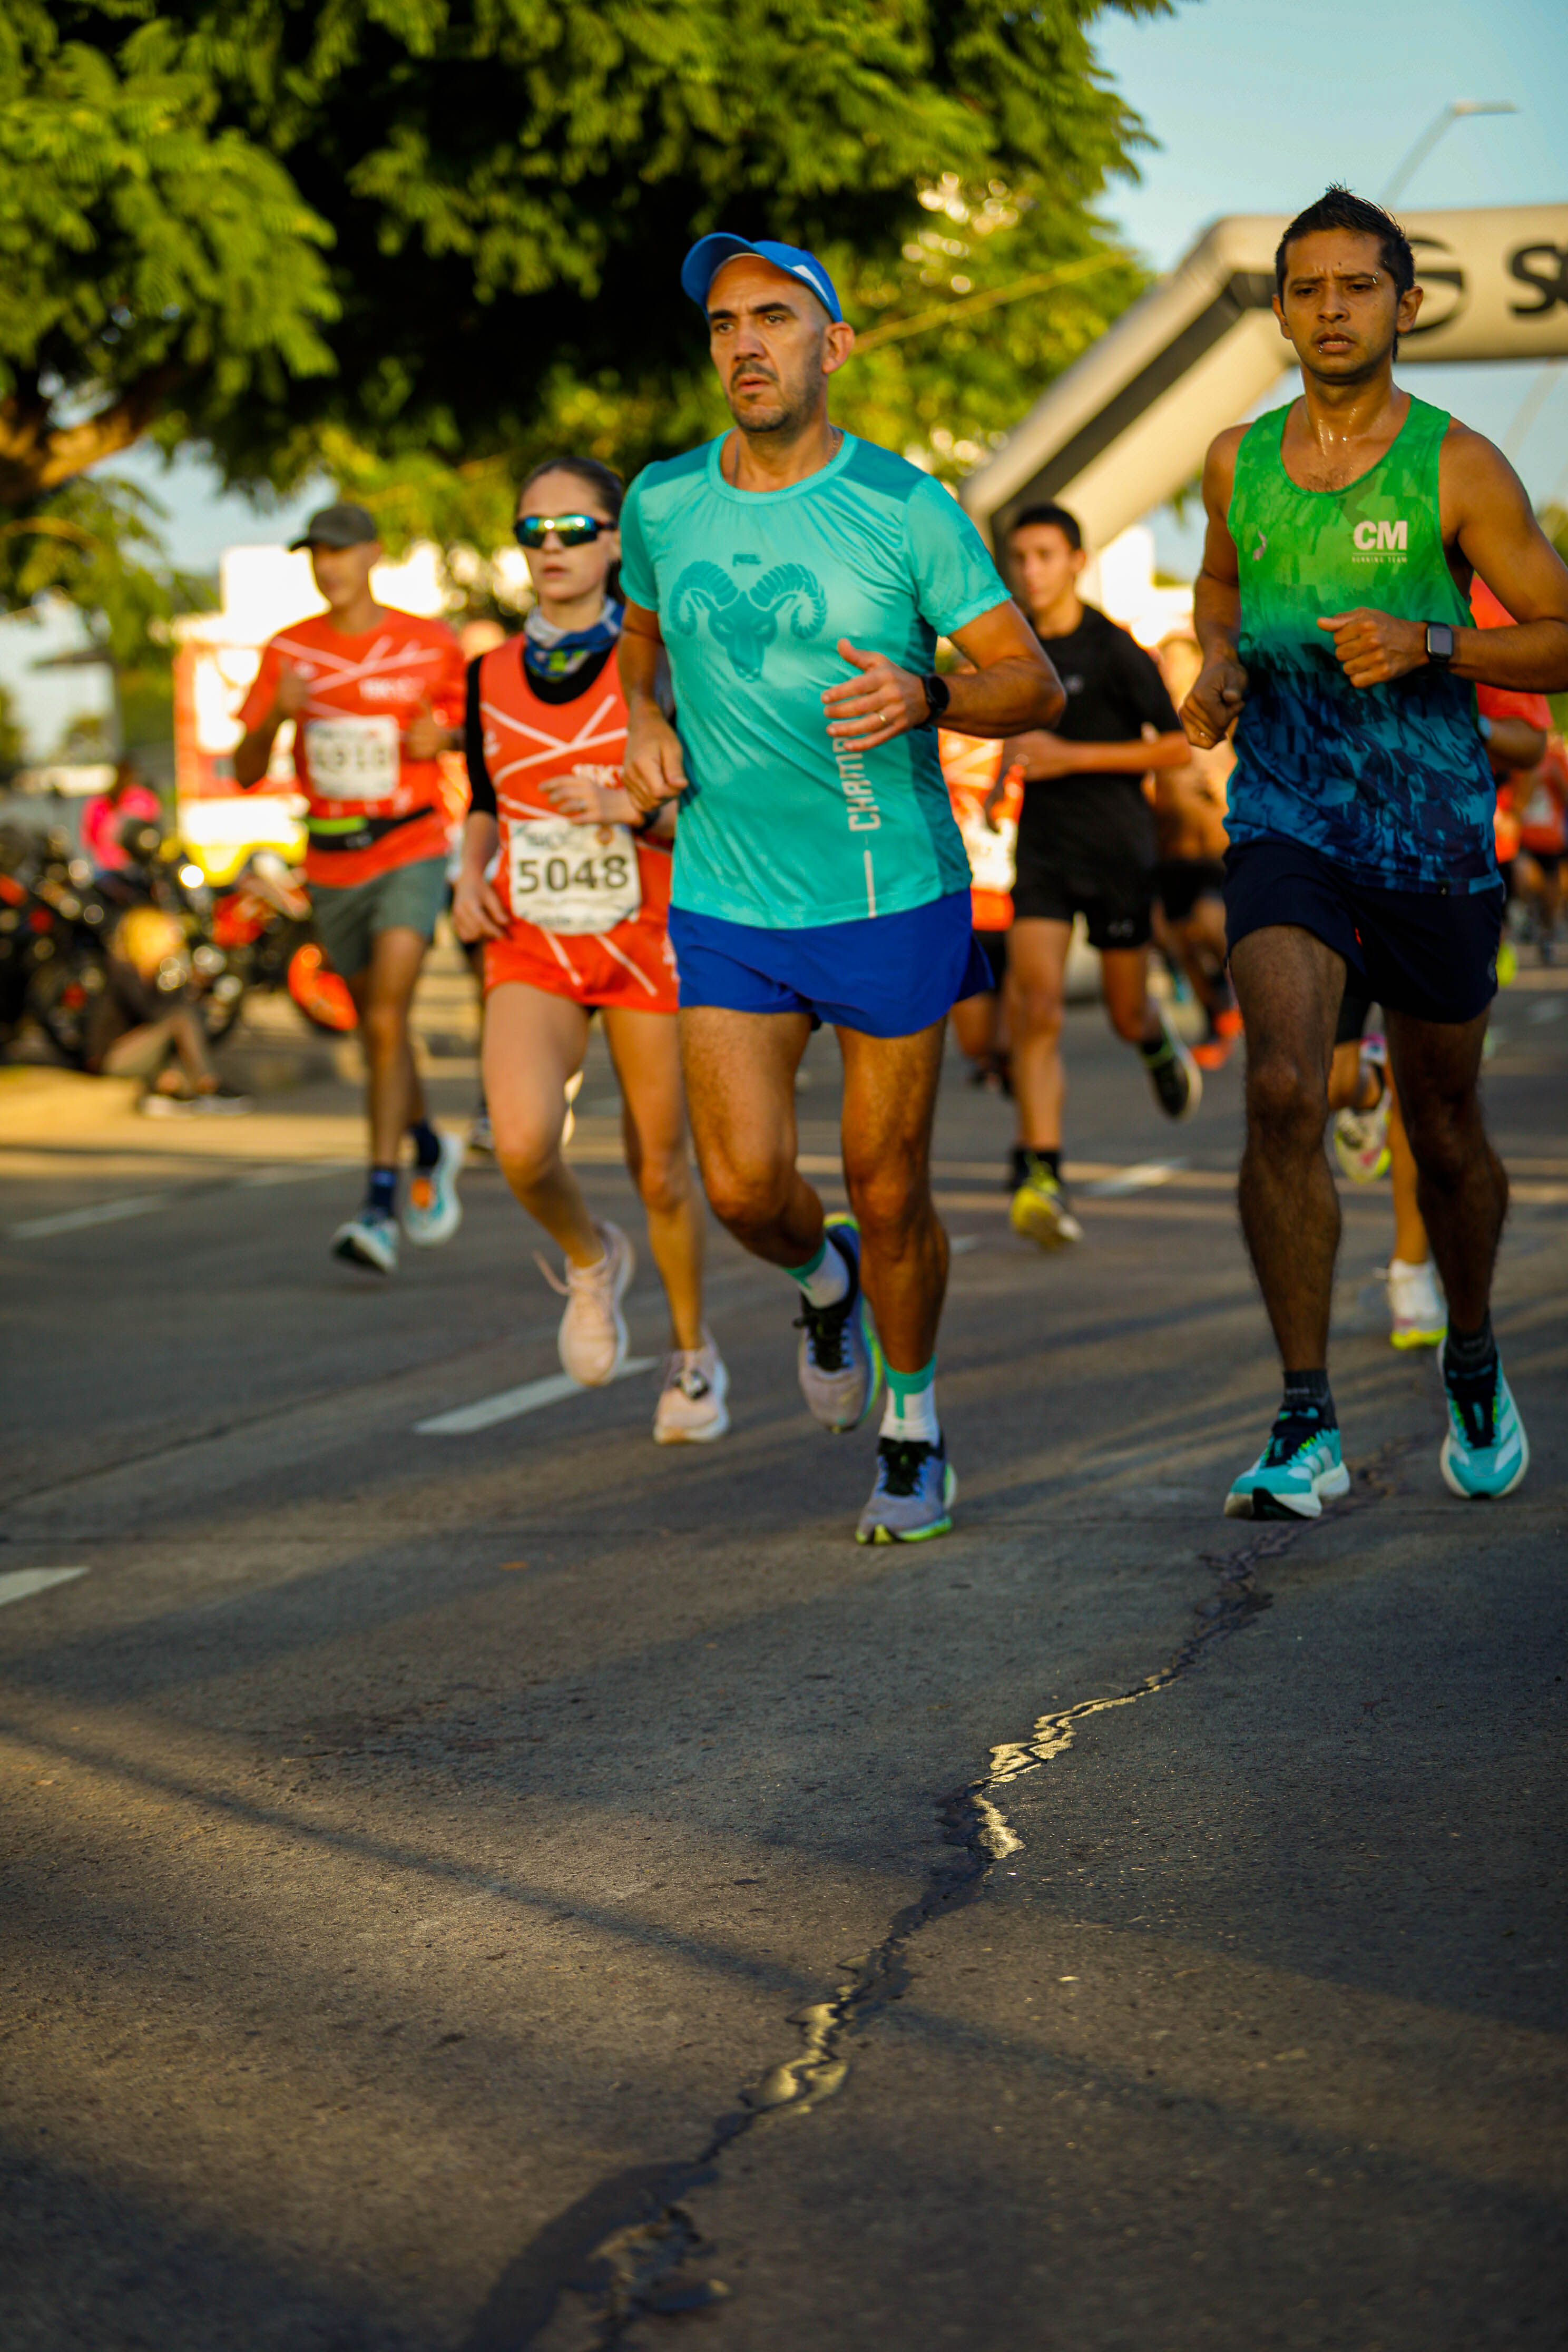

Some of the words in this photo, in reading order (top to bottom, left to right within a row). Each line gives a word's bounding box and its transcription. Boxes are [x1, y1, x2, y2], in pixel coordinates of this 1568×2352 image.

[1508, 240, 1568, 318] S
[1353, 520, 1408, 550] CM
[517, 855, 629, 894] 5048
